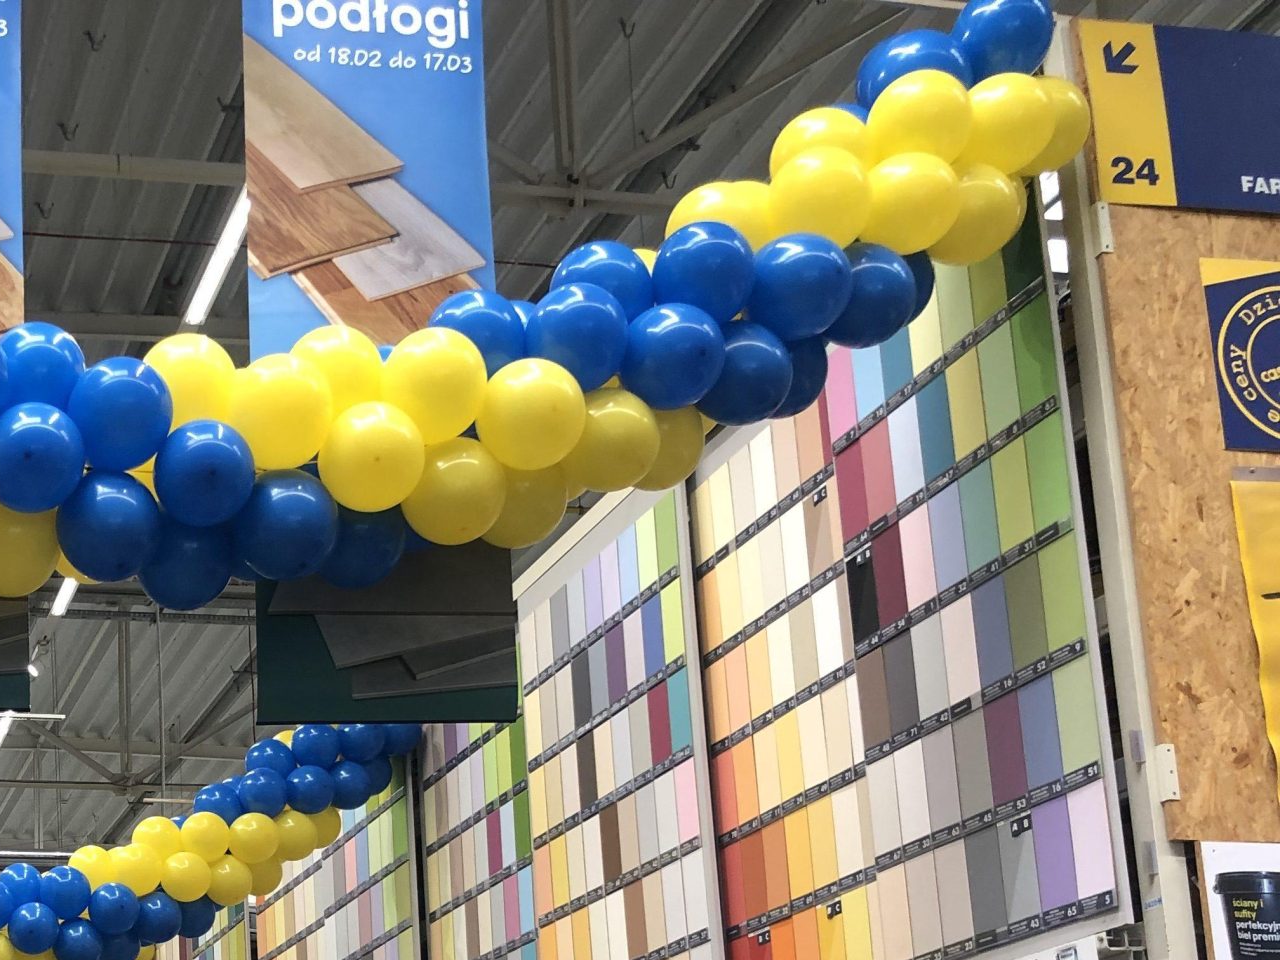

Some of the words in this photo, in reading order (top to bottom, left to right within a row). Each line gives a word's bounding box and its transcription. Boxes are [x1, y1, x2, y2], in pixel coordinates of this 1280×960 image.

[272, 0, 470, 49] podłogi
[294, 44, 321, 63] od
[328, 46, 382, 68] 18.02
[389, 50, 416, 69] do
[423, 53, 473, 74] 17.03
[1110, 156, 1160, 186] 24
